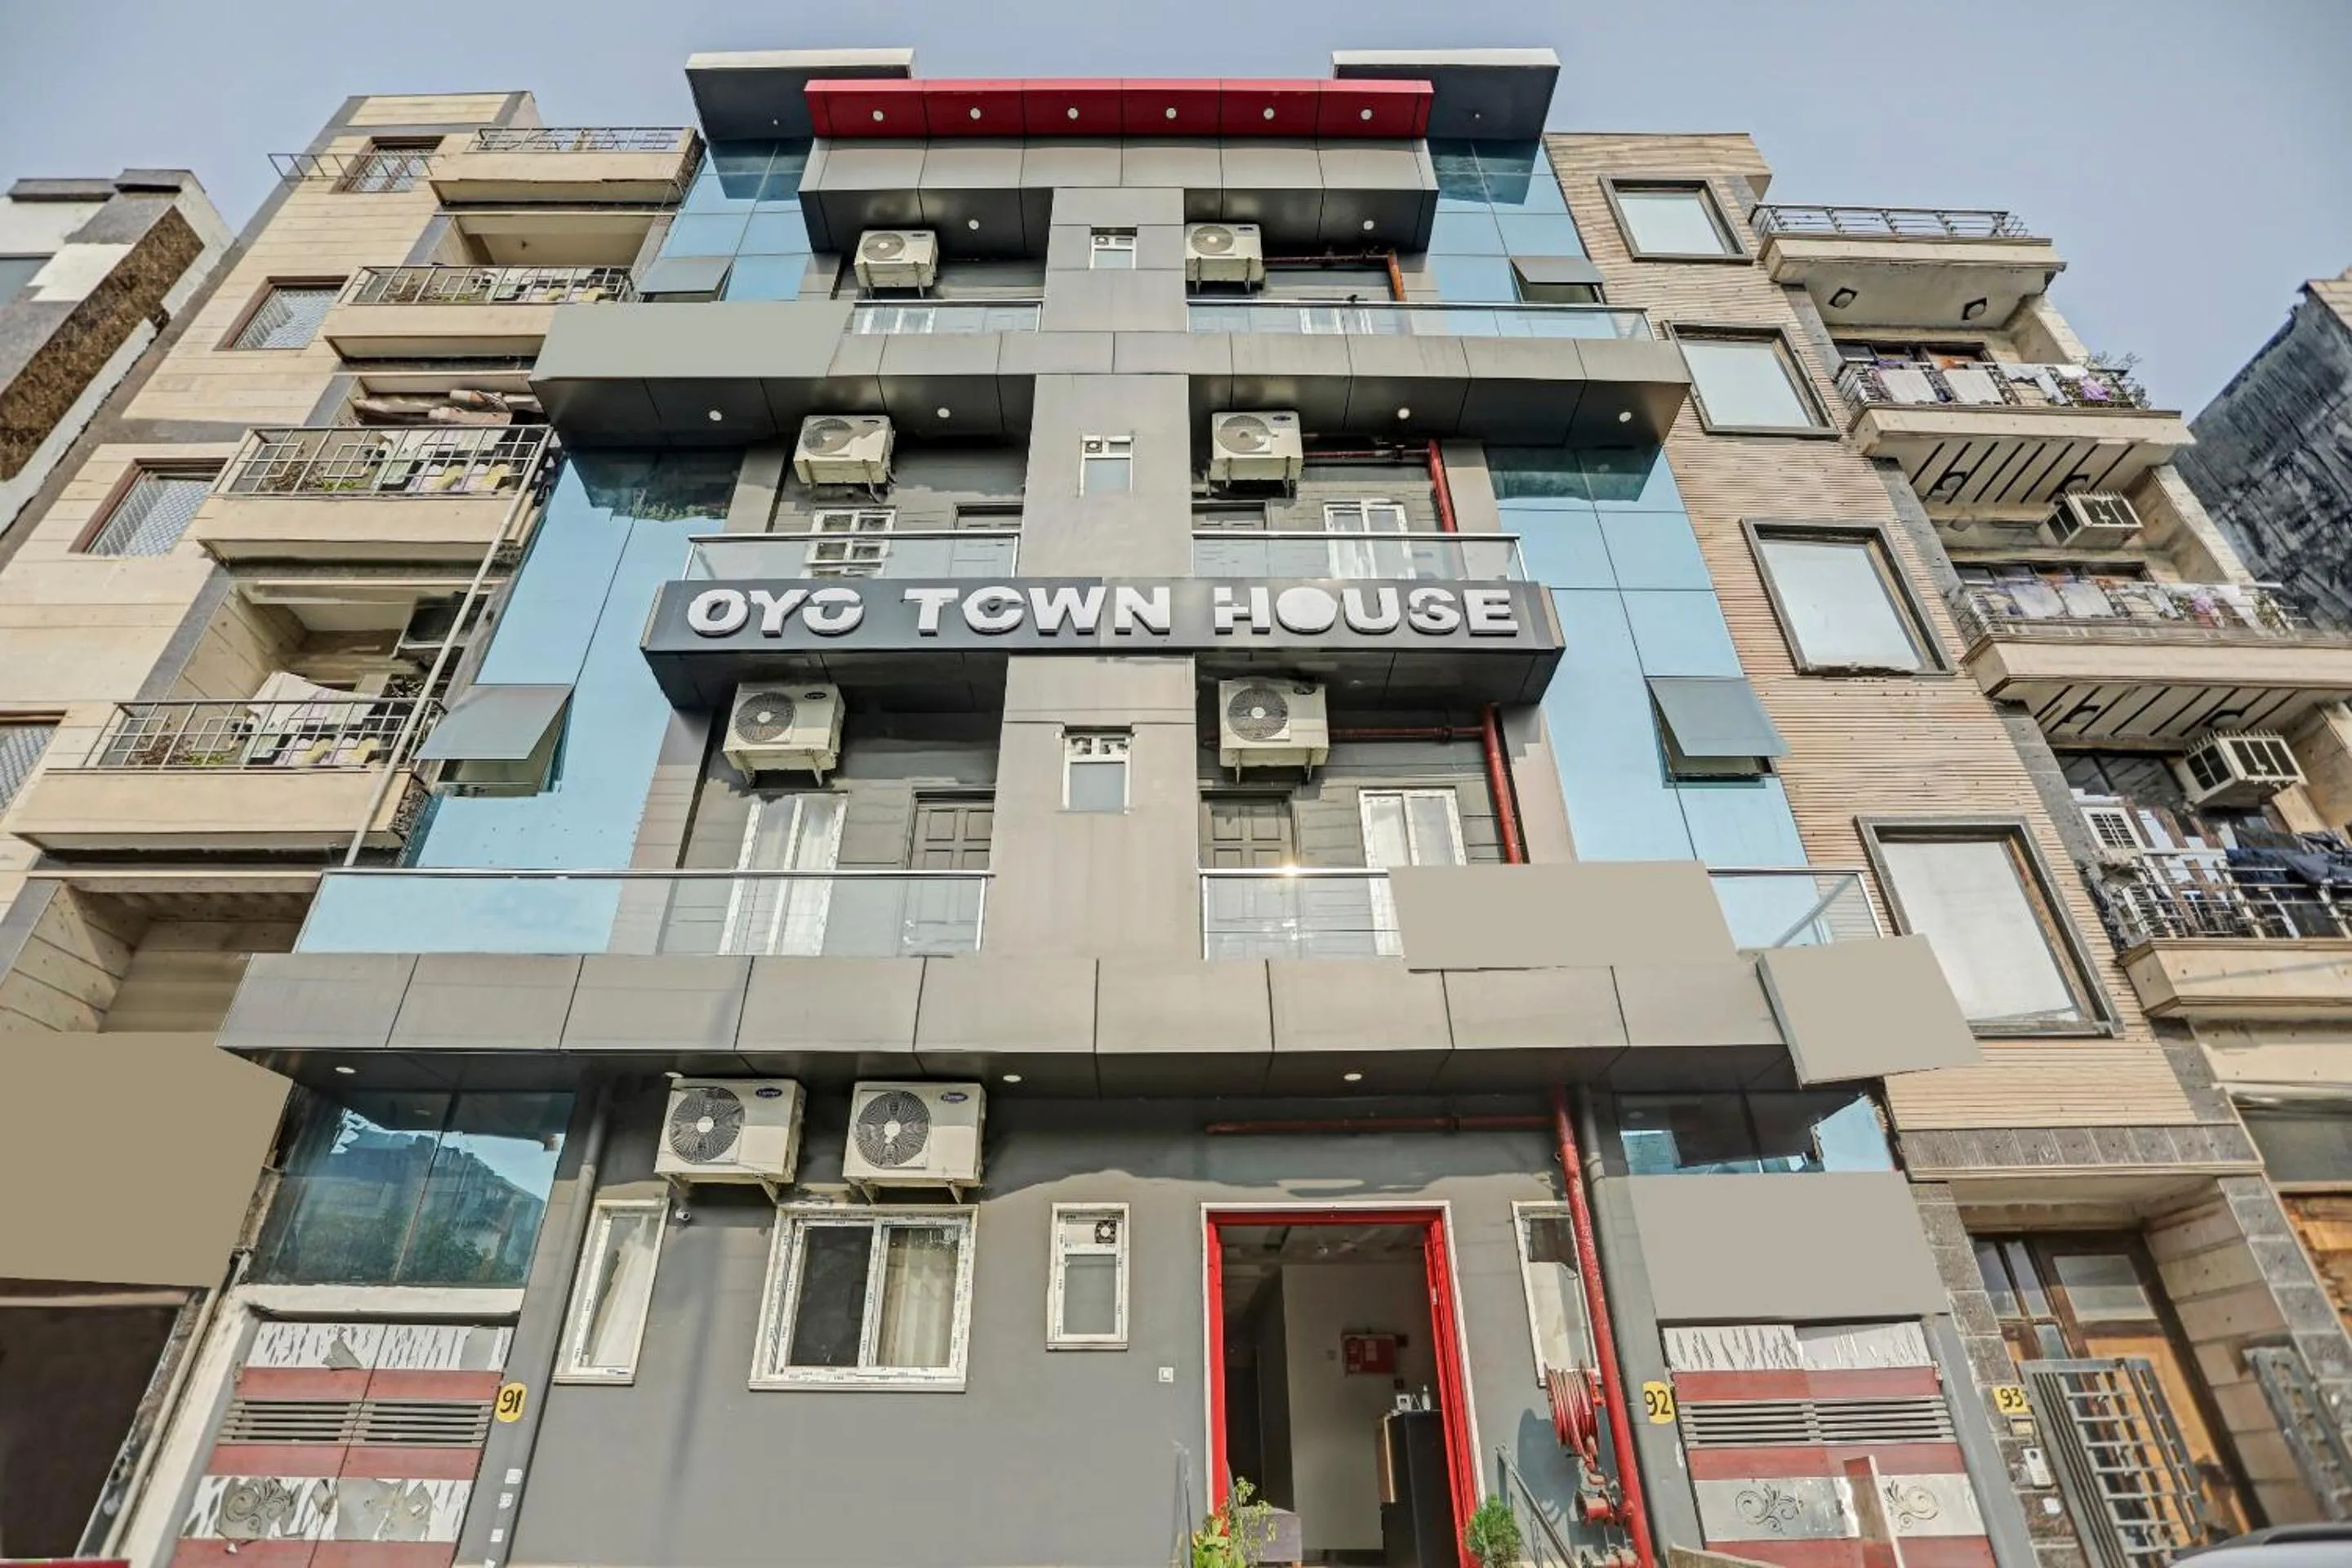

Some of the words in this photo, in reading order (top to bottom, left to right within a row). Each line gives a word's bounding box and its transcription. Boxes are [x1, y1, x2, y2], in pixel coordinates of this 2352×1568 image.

[688, 587, 866, 638] OYO
[902, 586, 1171, 636] TOWN
[1214, 586, 1519, 636] HOUSE
[500, 1389, 523, 1414] 91
[1644, 1390, 1671, 1416] 92
[1999, 1388, 2024, 1410] 93
